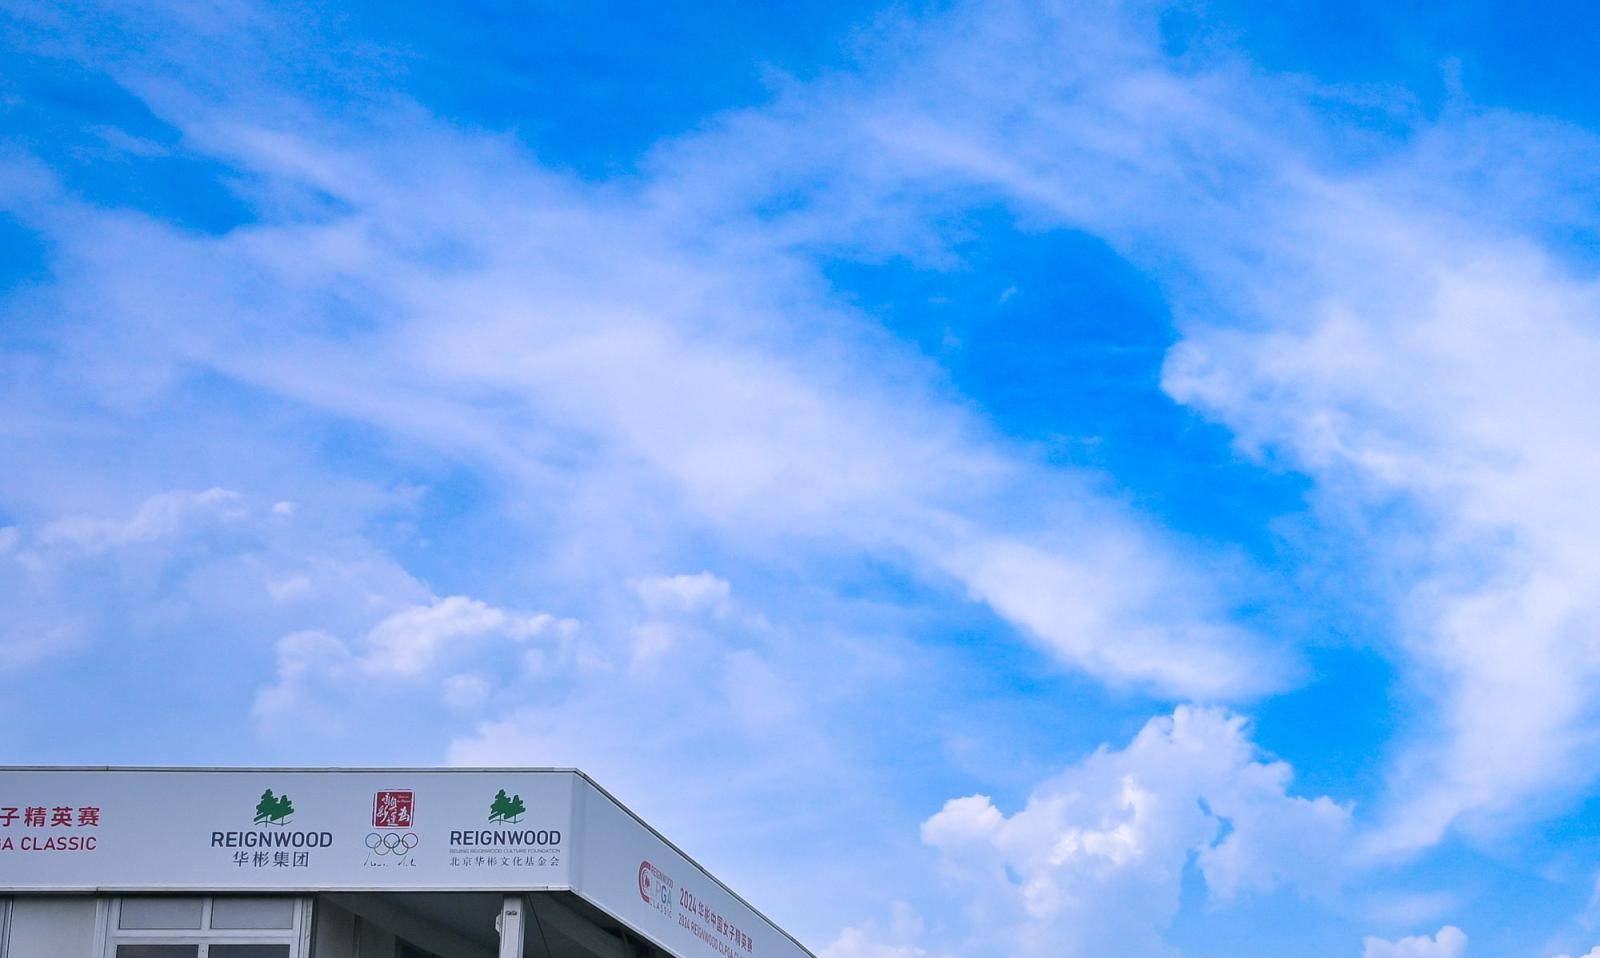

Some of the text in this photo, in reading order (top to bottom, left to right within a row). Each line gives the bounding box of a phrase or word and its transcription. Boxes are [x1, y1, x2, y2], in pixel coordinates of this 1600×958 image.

[21, 836, 97, 851] CLASSIC
[211, 831, 333, 848] REIGNWOOD
[450, 830, 561, 845] REIGNWOOD
[232, 850, 309, 868] 华彬集团
[680, 887, 696, 915] 2024
